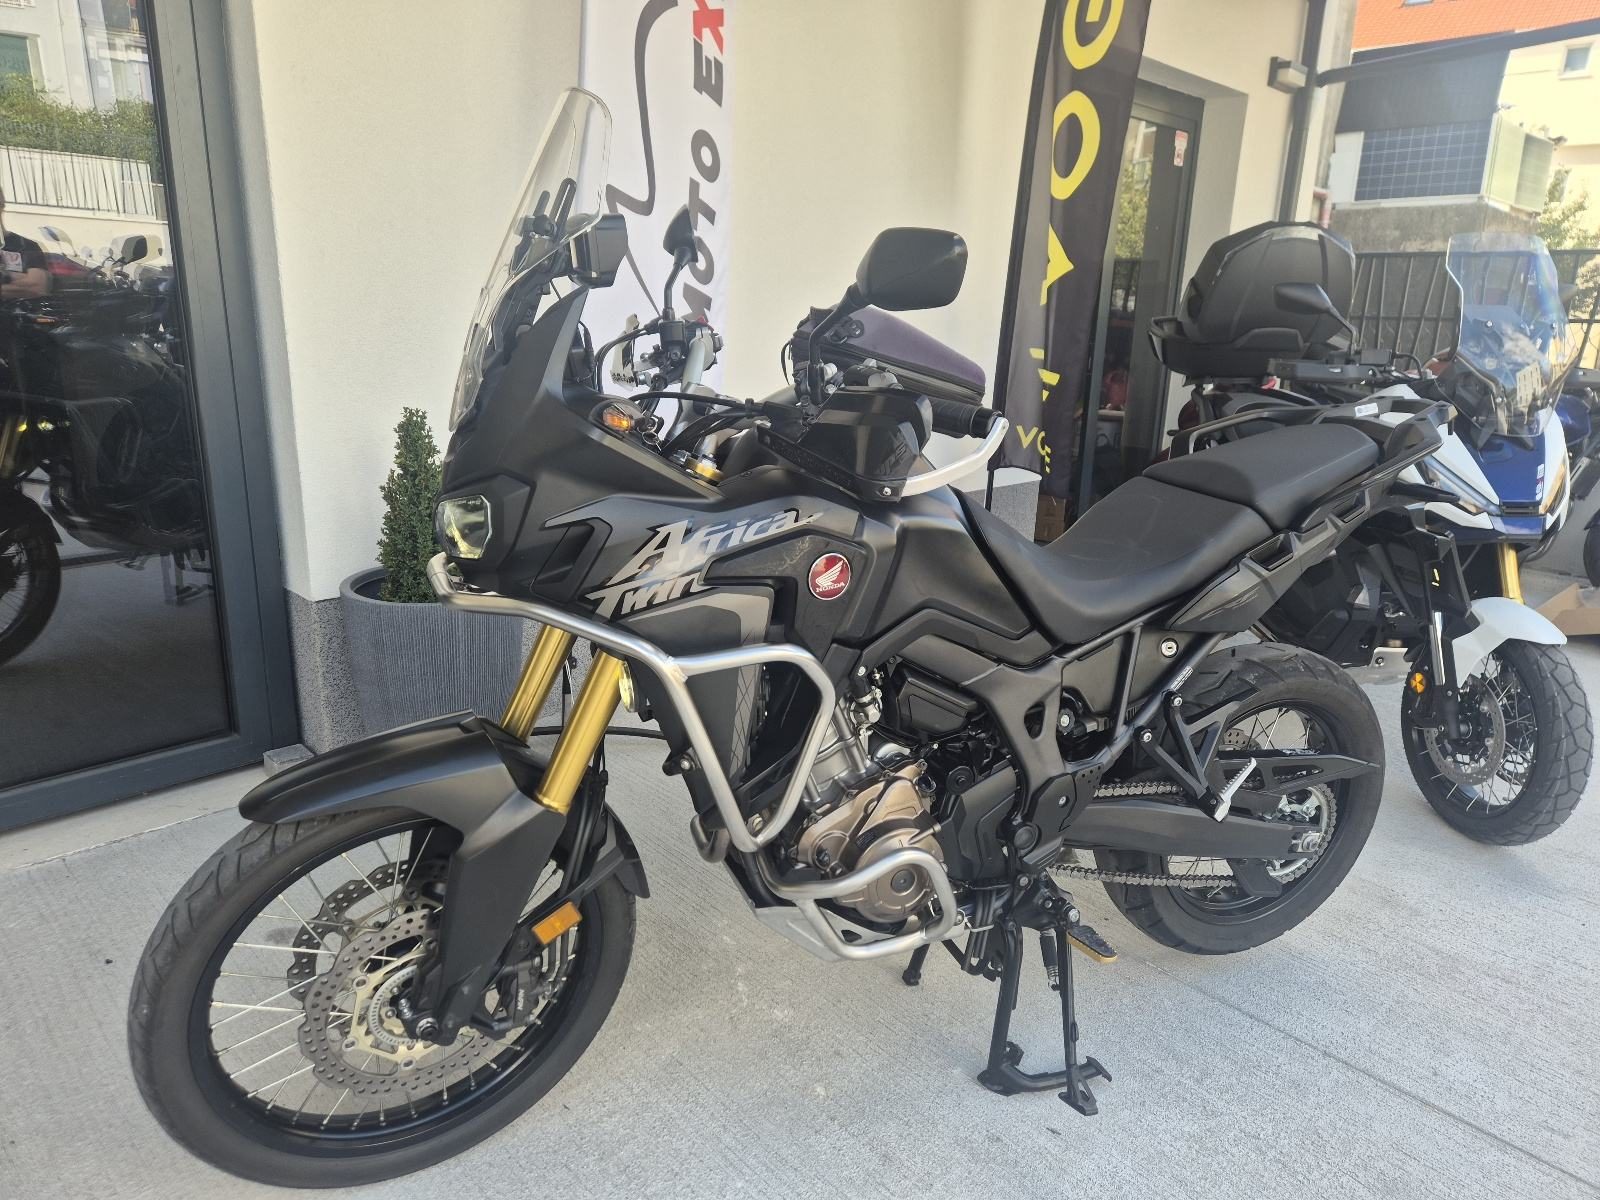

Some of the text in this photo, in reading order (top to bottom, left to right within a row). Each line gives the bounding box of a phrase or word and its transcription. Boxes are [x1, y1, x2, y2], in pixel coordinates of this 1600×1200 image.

[680, 129, 721, 324] MOTO
[604, 508, 824, 586] Africa
[584, 571, 714, 620] Twin
[815, 581, 846, 593] HONDA
